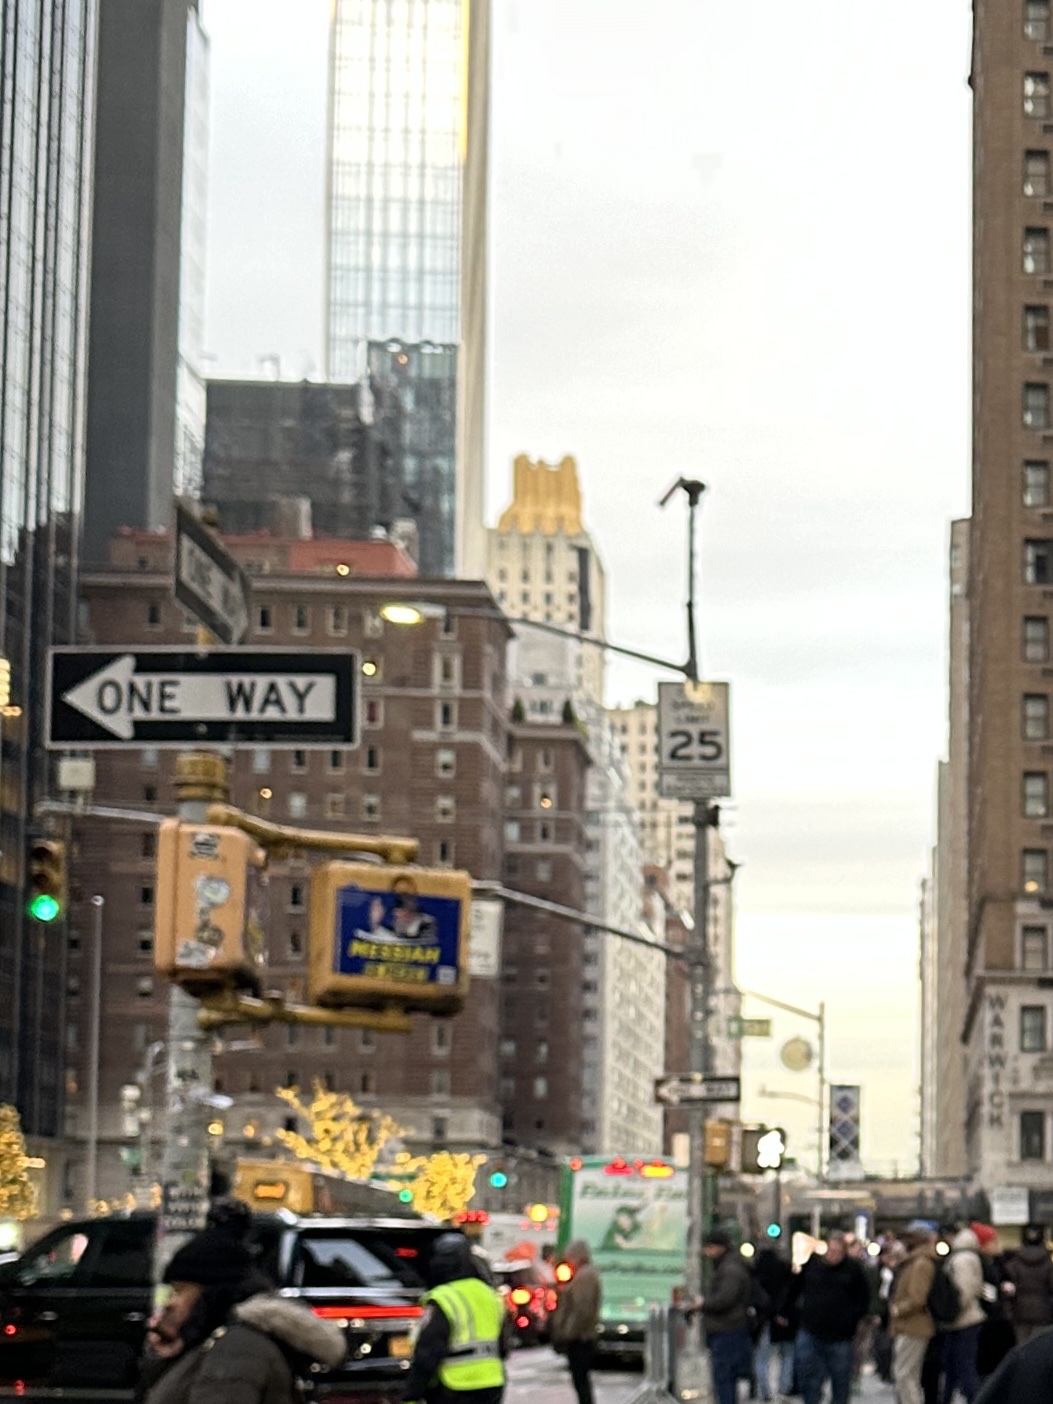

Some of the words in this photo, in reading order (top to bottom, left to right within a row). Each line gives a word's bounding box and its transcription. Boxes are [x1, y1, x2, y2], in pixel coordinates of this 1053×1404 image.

[97, 679, 181, 715] ONE
[225, 680, 316, 715] WAY
[669, 730, 723, 761] 25
[350, 940, 441, 964] MESSIAH
[988, 994, 1006, 1127] WARWICK
